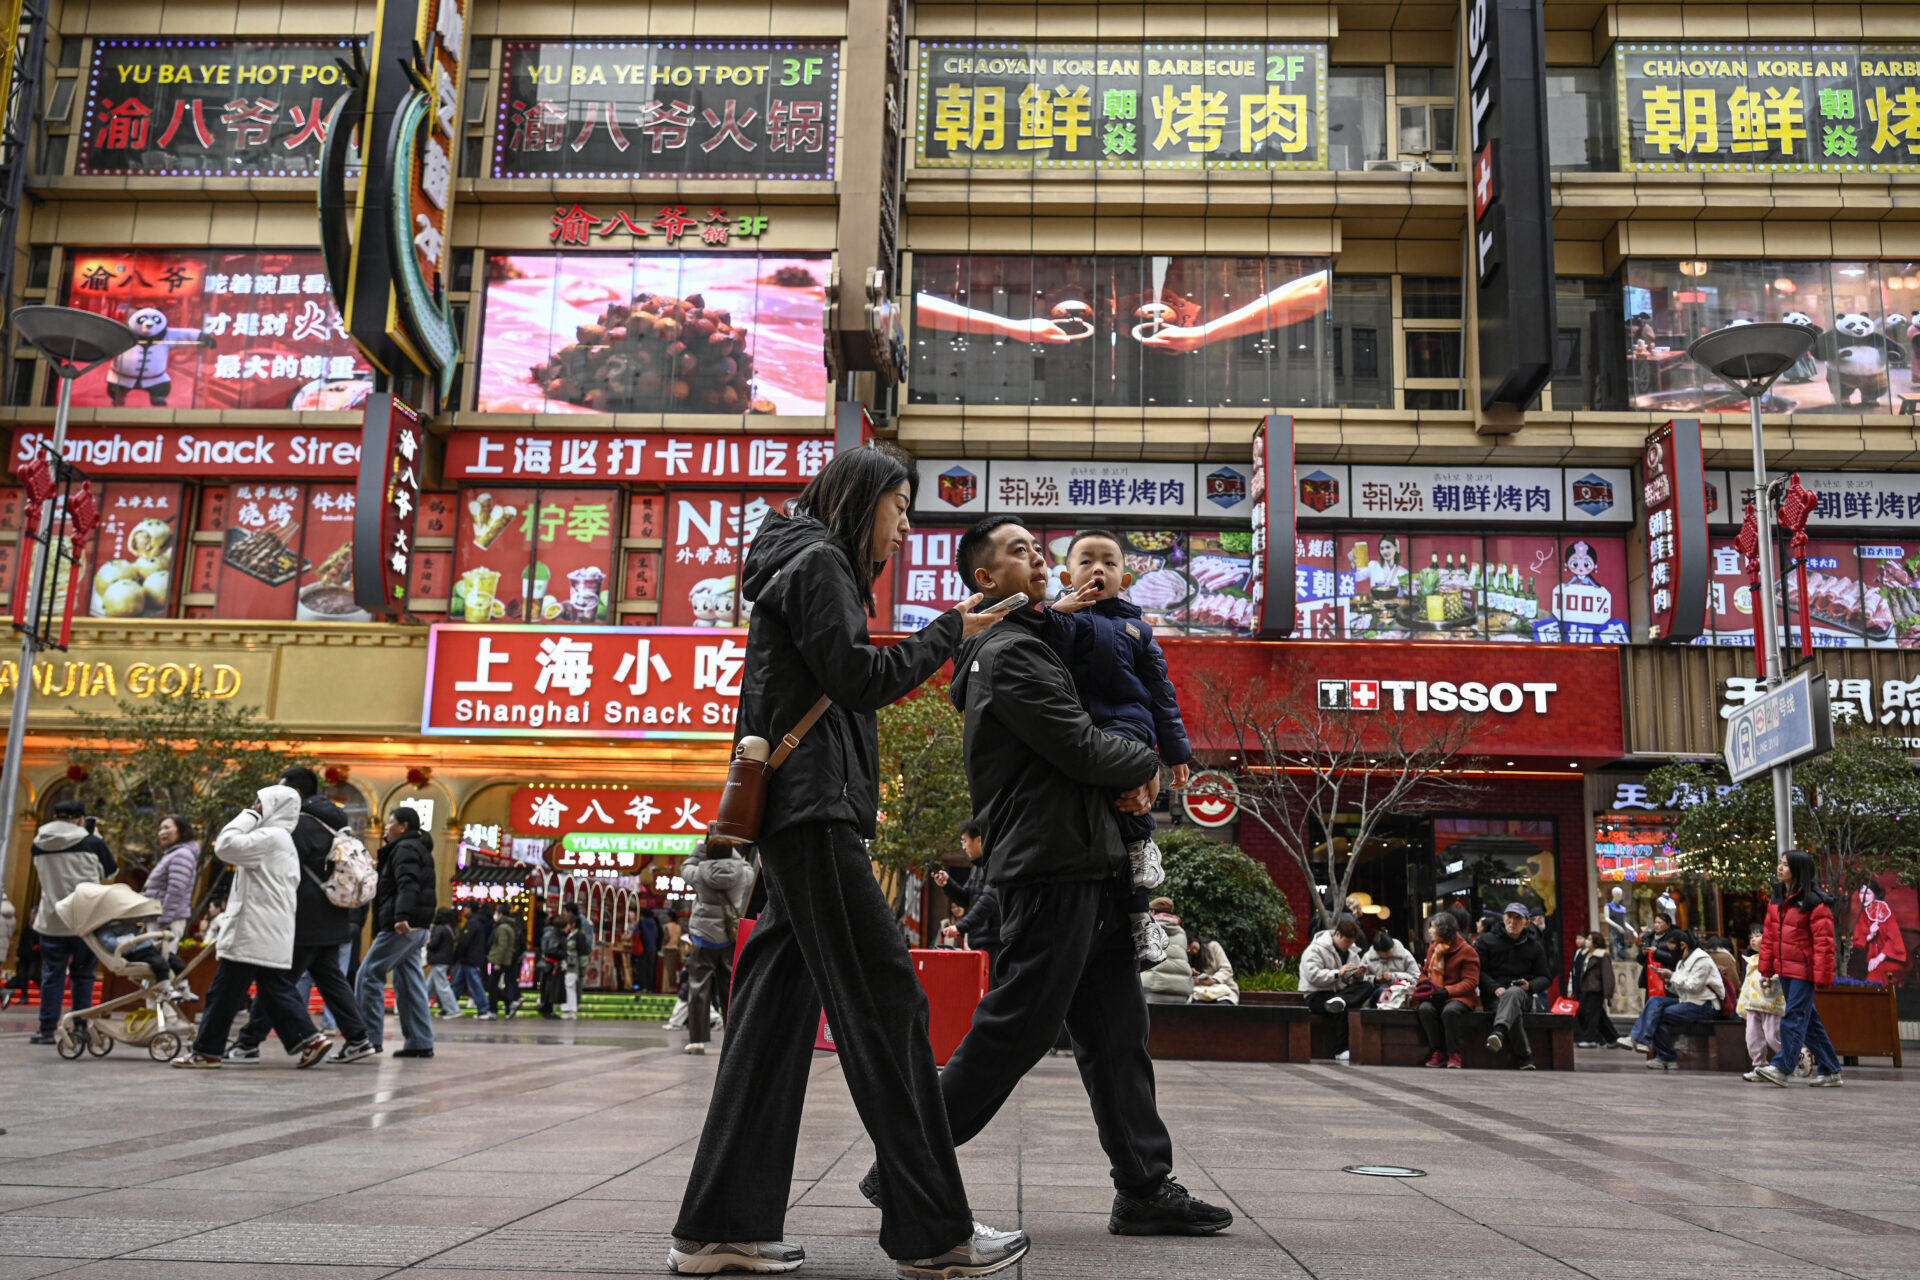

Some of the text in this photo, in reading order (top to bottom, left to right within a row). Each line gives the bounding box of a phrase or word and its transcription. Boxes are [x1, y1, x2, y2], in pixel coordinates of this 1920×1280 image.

[117, 64, 152, 84] YU
[157, 64, 193, 84] BA
[199, 64, 231, 85] YE
[237, 64, 296, 85] HOT
[528, 58, 823, 86] YU BA YE HOT POT 3F
[943, 56, 1304, 81] CHAOYAN KOREAN BARBECUE 2F
[1643, 60, 1747, 77] CHAOYAN
[1757, 61, 1848, 77] KOREAN
[508, 99, 824, 154] 渝八爷火锅
[933, 83, 1308, 154] 朝鲜 烤肉
[1642, 85, 1808, 156] 朝鲜
[549, 204, 768, 245] 渝八爷 3F
[80, 265, 193, 293] 渝八爷
[205, 273, 331, 295] 吃着碗里看
[176, 434, 274, 465] Snack
[289, 435, 361, 465] Stre
[465, 436, 836, 477] 上海必打卡小吃街
[1068, 479, 1185, 506] 朝鲜烤肉
[1432, 485, 1551, 513] 朝鲜烤肉
[519, 502, 611, 544] 柠季
[907, 534, 963, 566] 10
[1555, 594, 1609, 614] 100%
[125, 661, 243, 700] GOLD
[454, 637, 746, 697] 上海小吃
[1381, 680, 1558, 714] TISSOT
[455, 699, 590, 727] Shanghai
[605, 701, 692, 725] Snack
[571, 836, 693, 851] YUBAYE HOT POT
